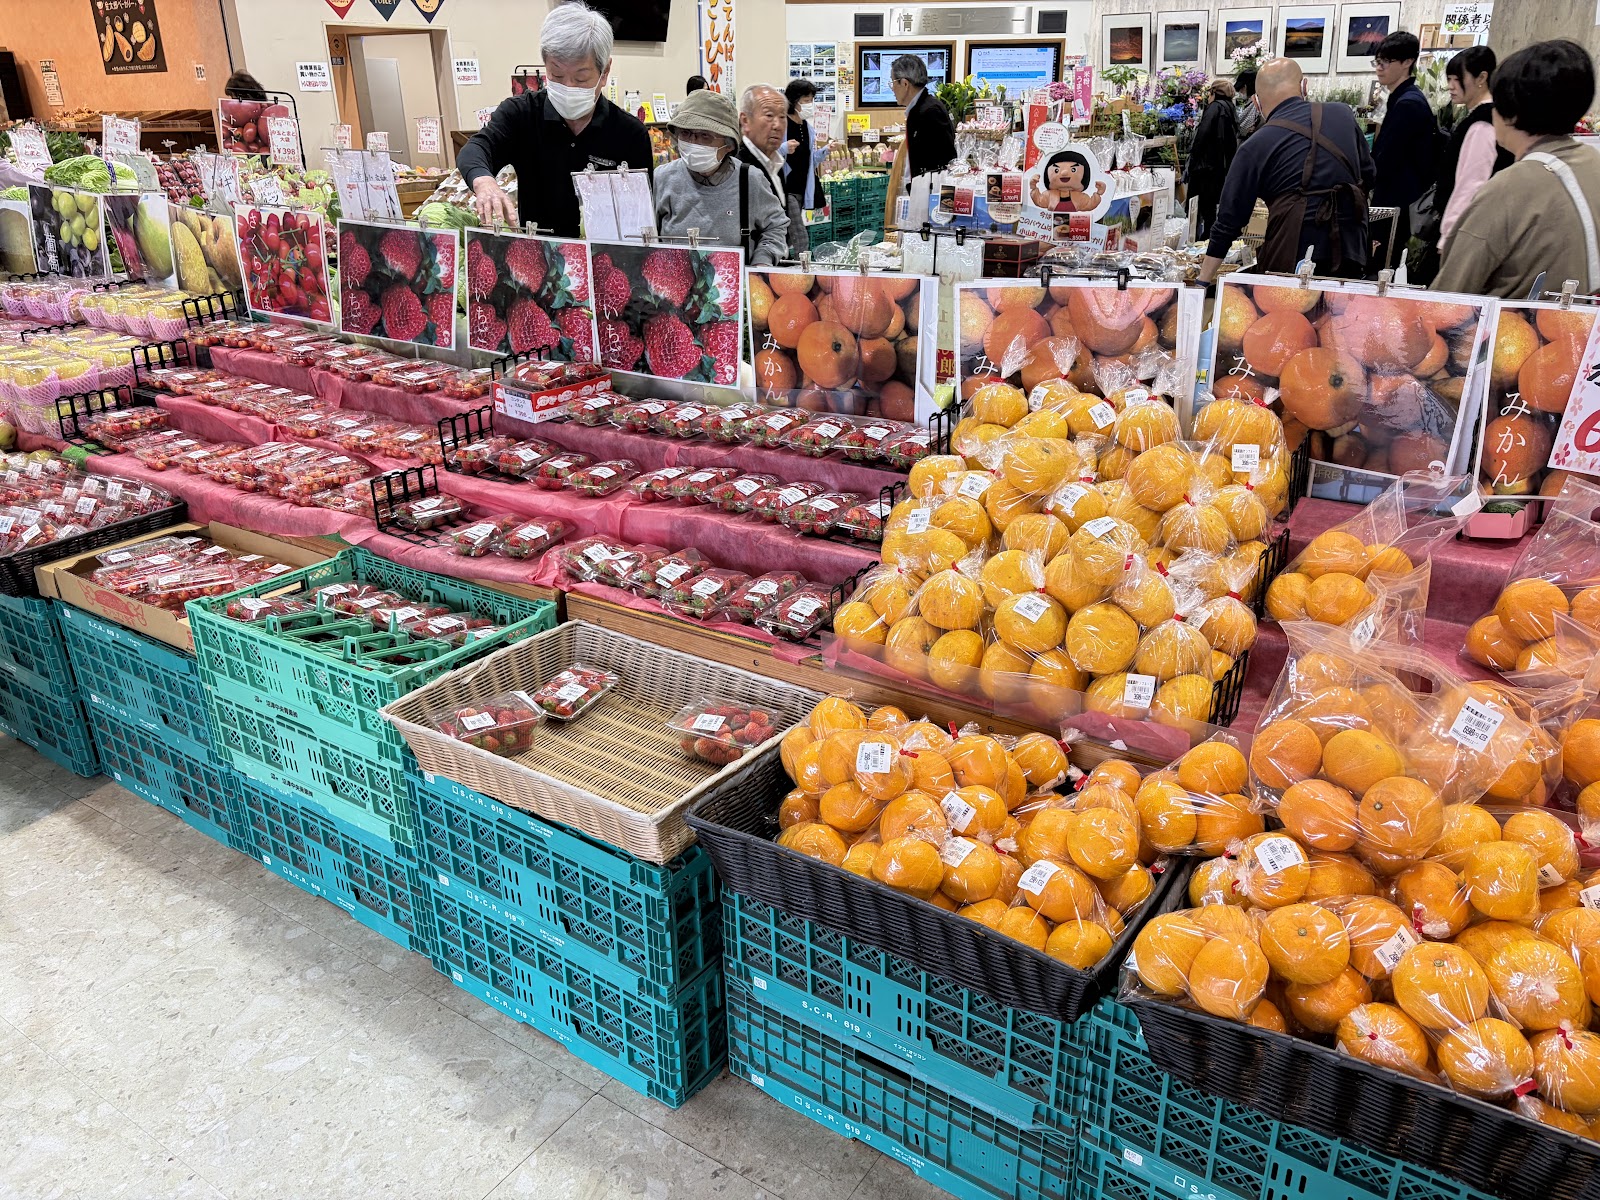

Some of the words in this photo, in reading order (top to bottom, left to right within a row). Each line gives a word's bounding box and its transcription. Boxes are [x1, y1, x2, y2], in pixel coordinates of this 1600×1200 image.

[723, 0, 734, 62] てんば
[896, 12, 1024, 33] 情報コーナー
[248, 214, 274, 311] さくらんぼ
[475, 287, 489, 345] いちご
[602, 303, 623, 366] いちご
[761, 333, 785, 401] みかん
[1491, 391, 1532, 489] みかん
[460, 789, 488, 808] S.C.R.
[474, 893, 501, 914] S.C.R.
[485, 990, 512, 1011] S.C.R.
[801, 1000, 838, 1024] S.C.R.
[843, 1020, 861, 1034] 619
[804, 1101, 840, 1126] S.C.R.
[844, 1122, 862, 1136] 619
